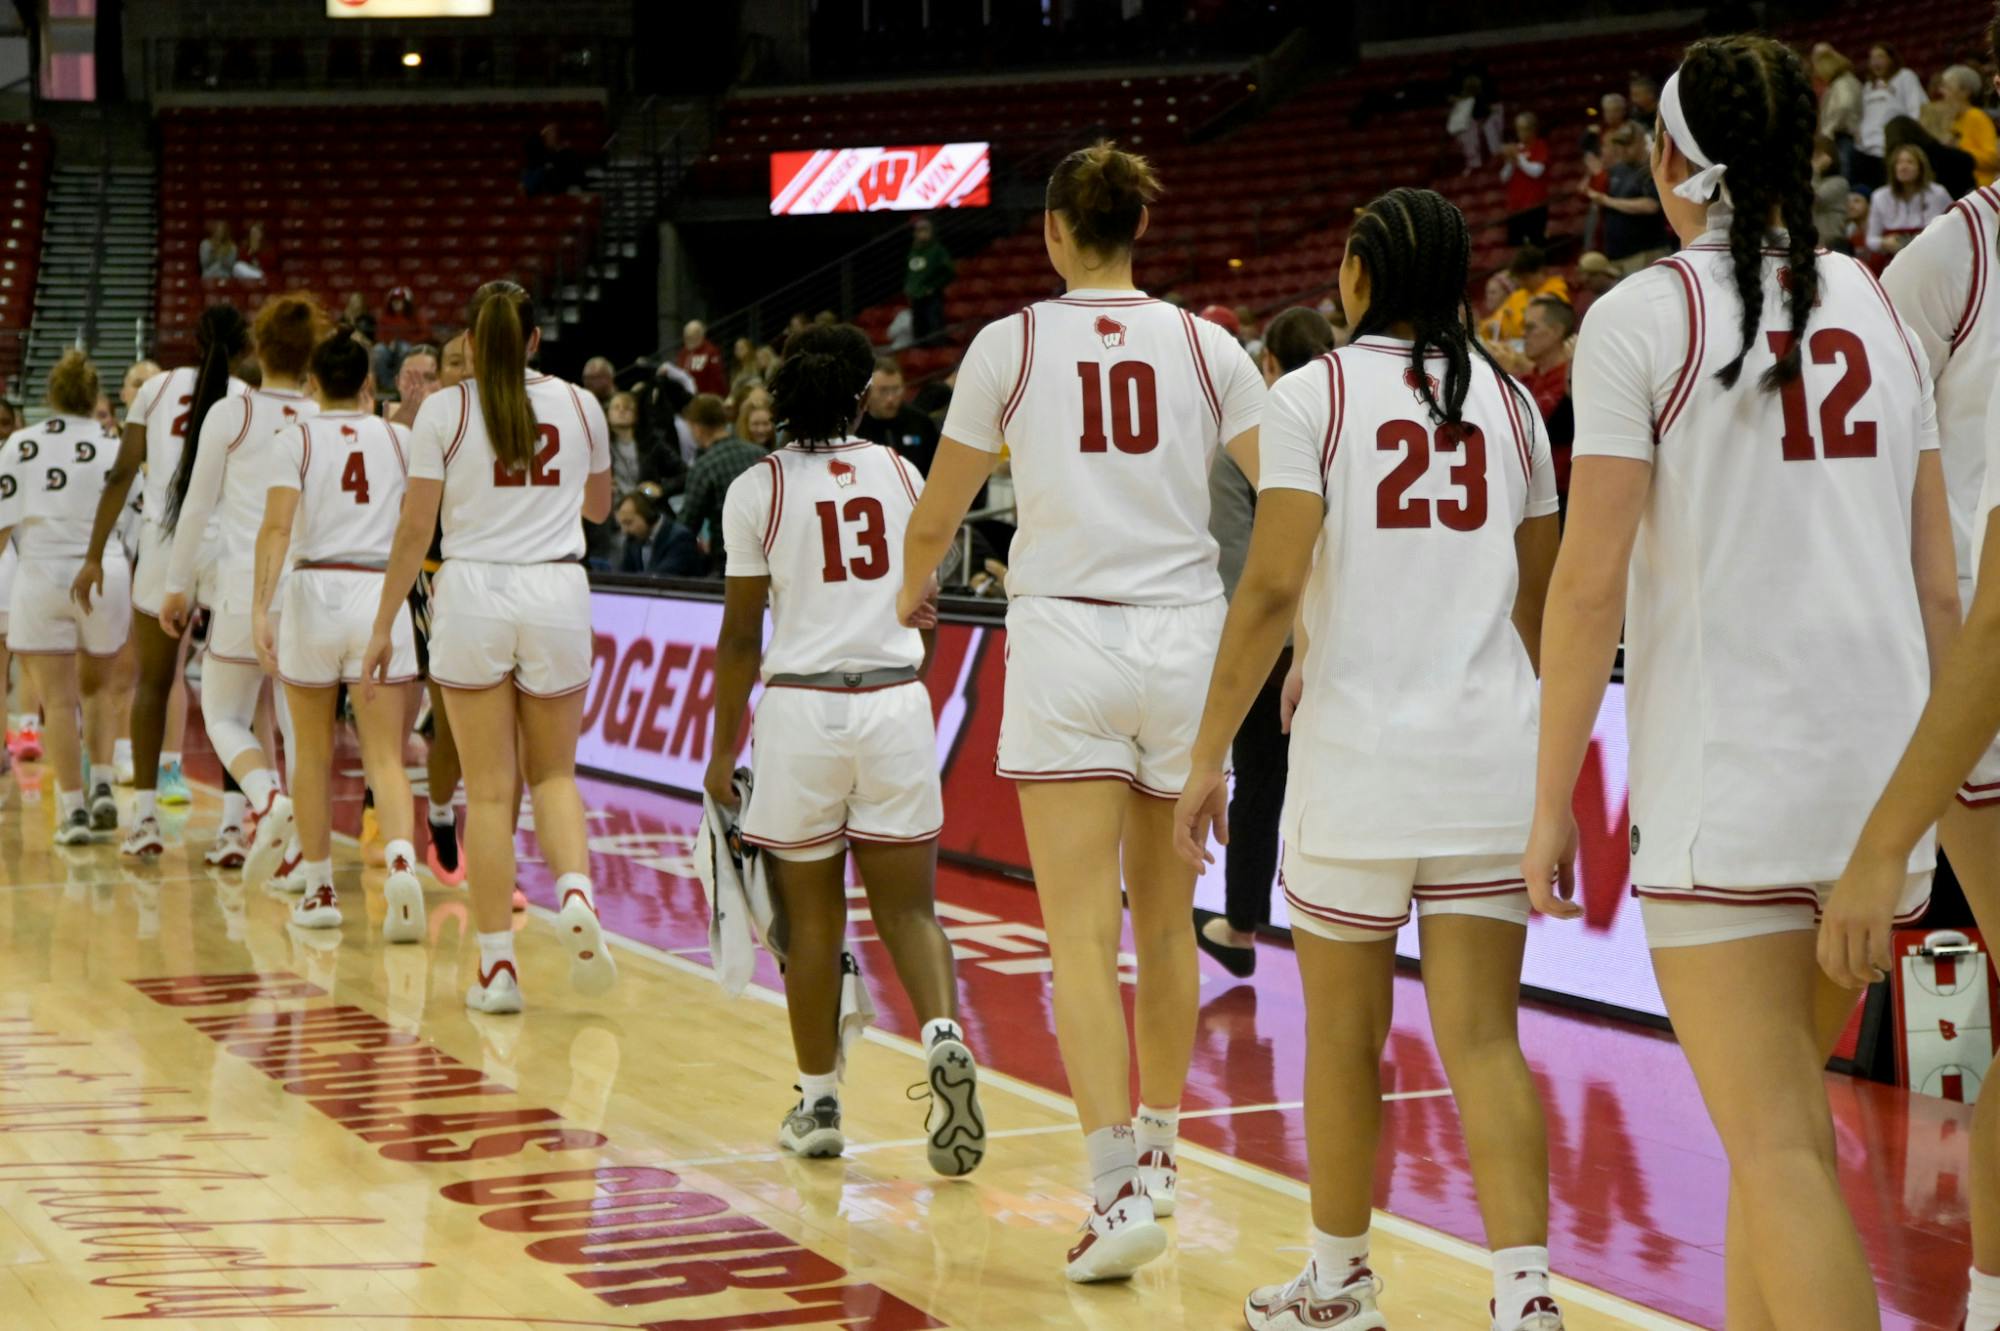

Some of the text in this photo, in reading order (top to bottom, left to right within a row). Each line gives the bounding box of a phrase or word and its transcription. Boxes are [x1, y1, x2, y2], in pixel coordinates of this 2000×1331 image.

[1077, 360, 1159, 454] 10
[1766, 327, 1877, 461] 12
[341, 451, 369, 504] 4
[494, 423, 560, 487] 2
[1376, 419, 1487, 531] 23
[815, 496, 890, 583] 13
[183, 1005, 608, 1163] NICHOLAS
[440, 1166, 950, 1331] COURT
